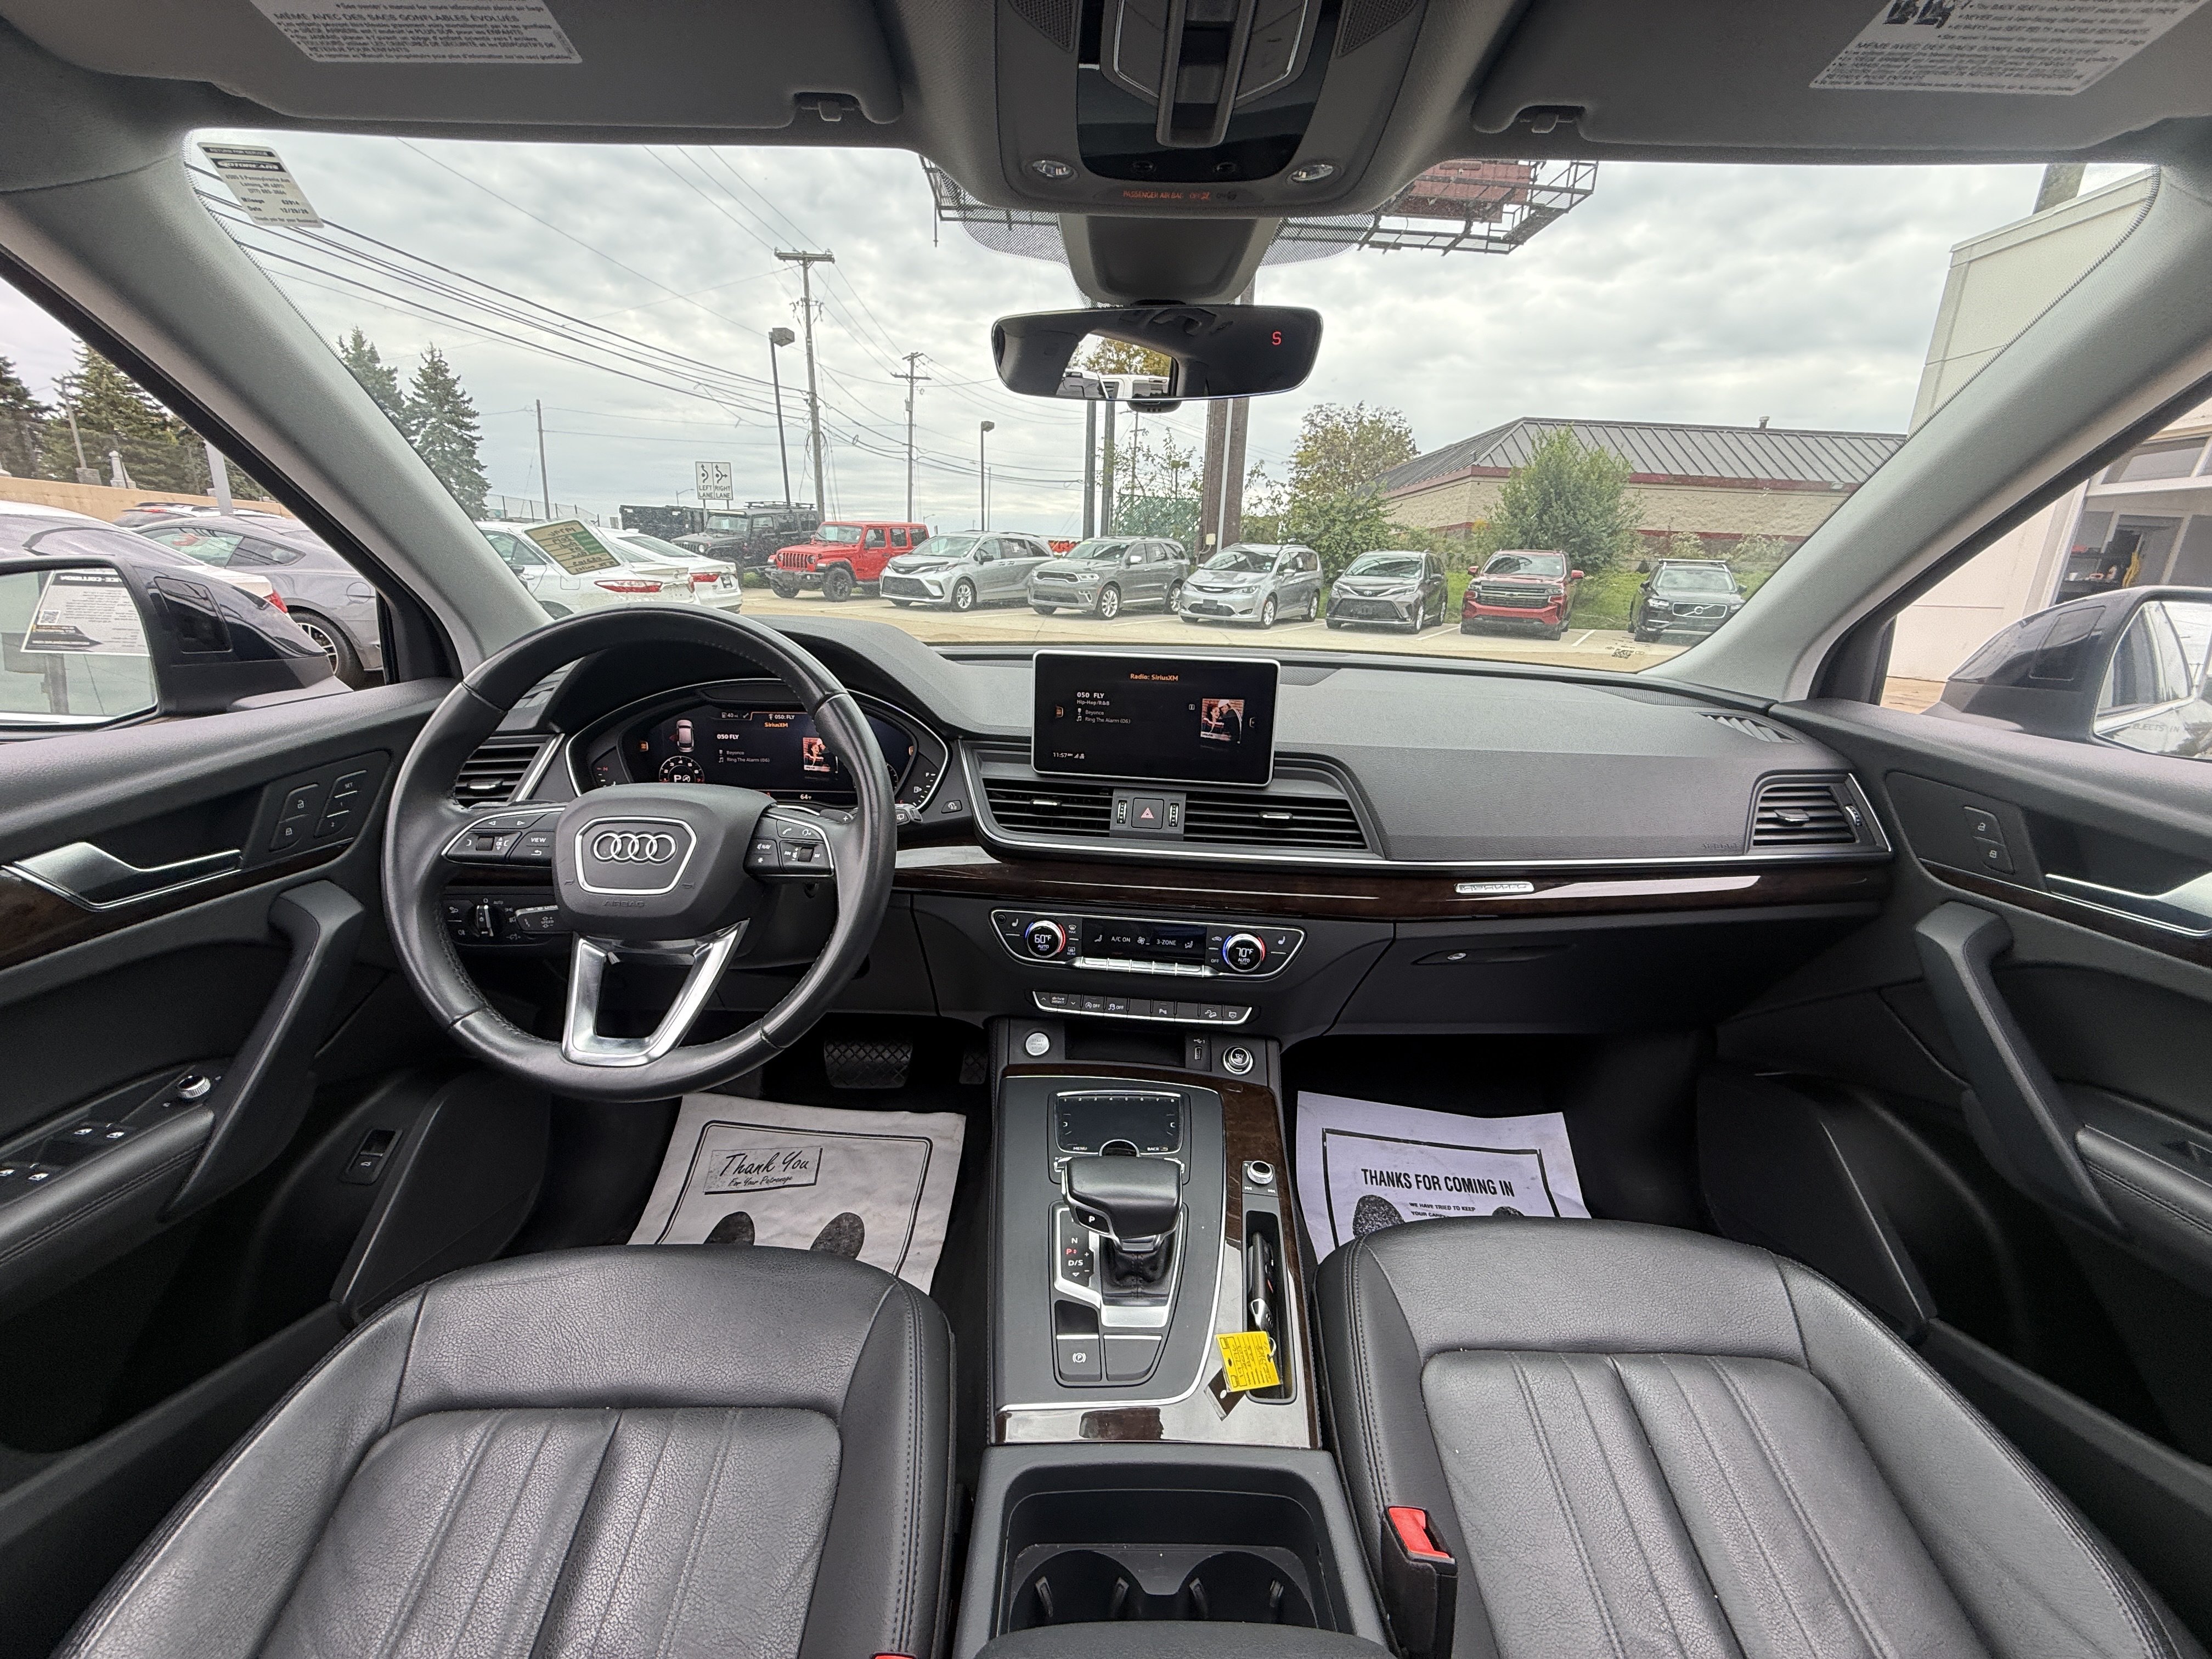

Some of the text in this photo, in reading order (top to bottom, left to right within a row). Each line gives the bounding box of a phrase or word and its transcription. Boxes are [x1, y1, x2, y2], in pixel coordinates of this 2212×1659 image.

[1123, 190, 1159, 199] PASSENGER
[1271, 331, 1282, 346] S
[673, 775, 682, 783] P
[719, 1150, 810, 1177] Thank You
[727, 1175, 793, 1187] For Your Patronage
[1361, 1168, 1515, 1197] THANKS FOR COMING IN
